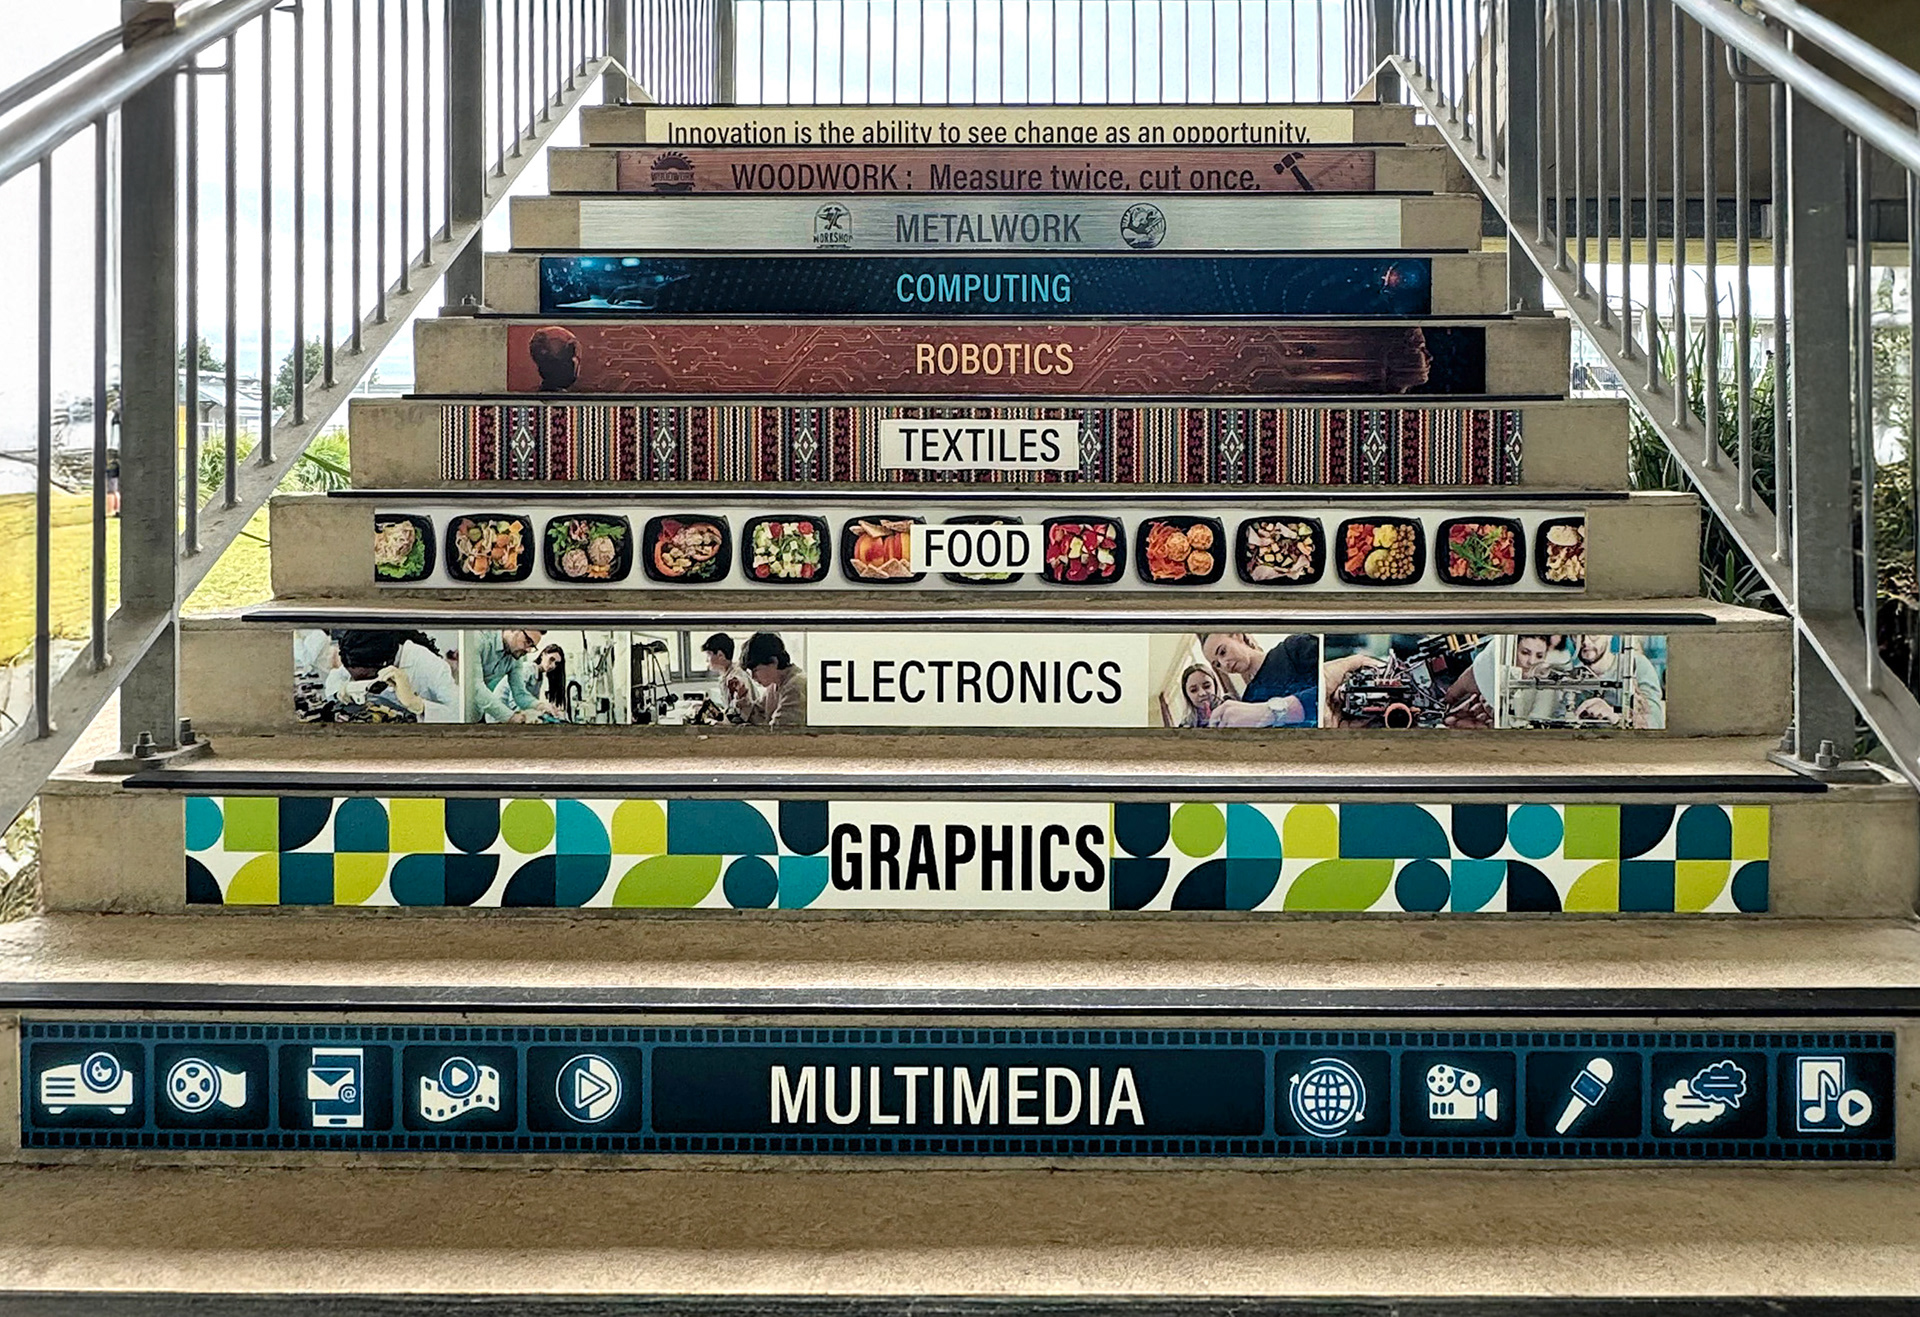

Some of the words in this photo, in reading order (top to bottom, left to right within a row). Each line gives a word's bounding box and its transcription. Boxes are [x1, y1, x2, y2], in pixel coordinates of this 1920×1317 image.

[668, 121, 786, 144] Innovation
[795, 121, 812, 144] is
[819, 121, 855, 144] the
[862, 120, 932, 144] ability
[939, 122, 961, 144] to
[968, 126, 1007, 144] see
[1015, 120, 1098, 144] change
[1106, 126, 1131, 144] as
[1138, 126, 1165, 144] an
[930, 164, 1042, 190] Measure
[1050, 163, 1131, 191] twice,
[1139, 165, 1182, 190] cut
[896, 214, 1082, 244] METALWORK
[896, 273, 1072, 303] COMPUTING
[916, 343, 1075, 376] ROBOTICS
[899, 428, 1061, 463] TEXTILES
[925, 529, 1030, 568] FOOD
[820, 660, 1122, 704] ELECTRONICS
[830, 823, 1106, 892] GRAPHICS
[770, 1065, 1145, 1126] MULTIMEDIA
